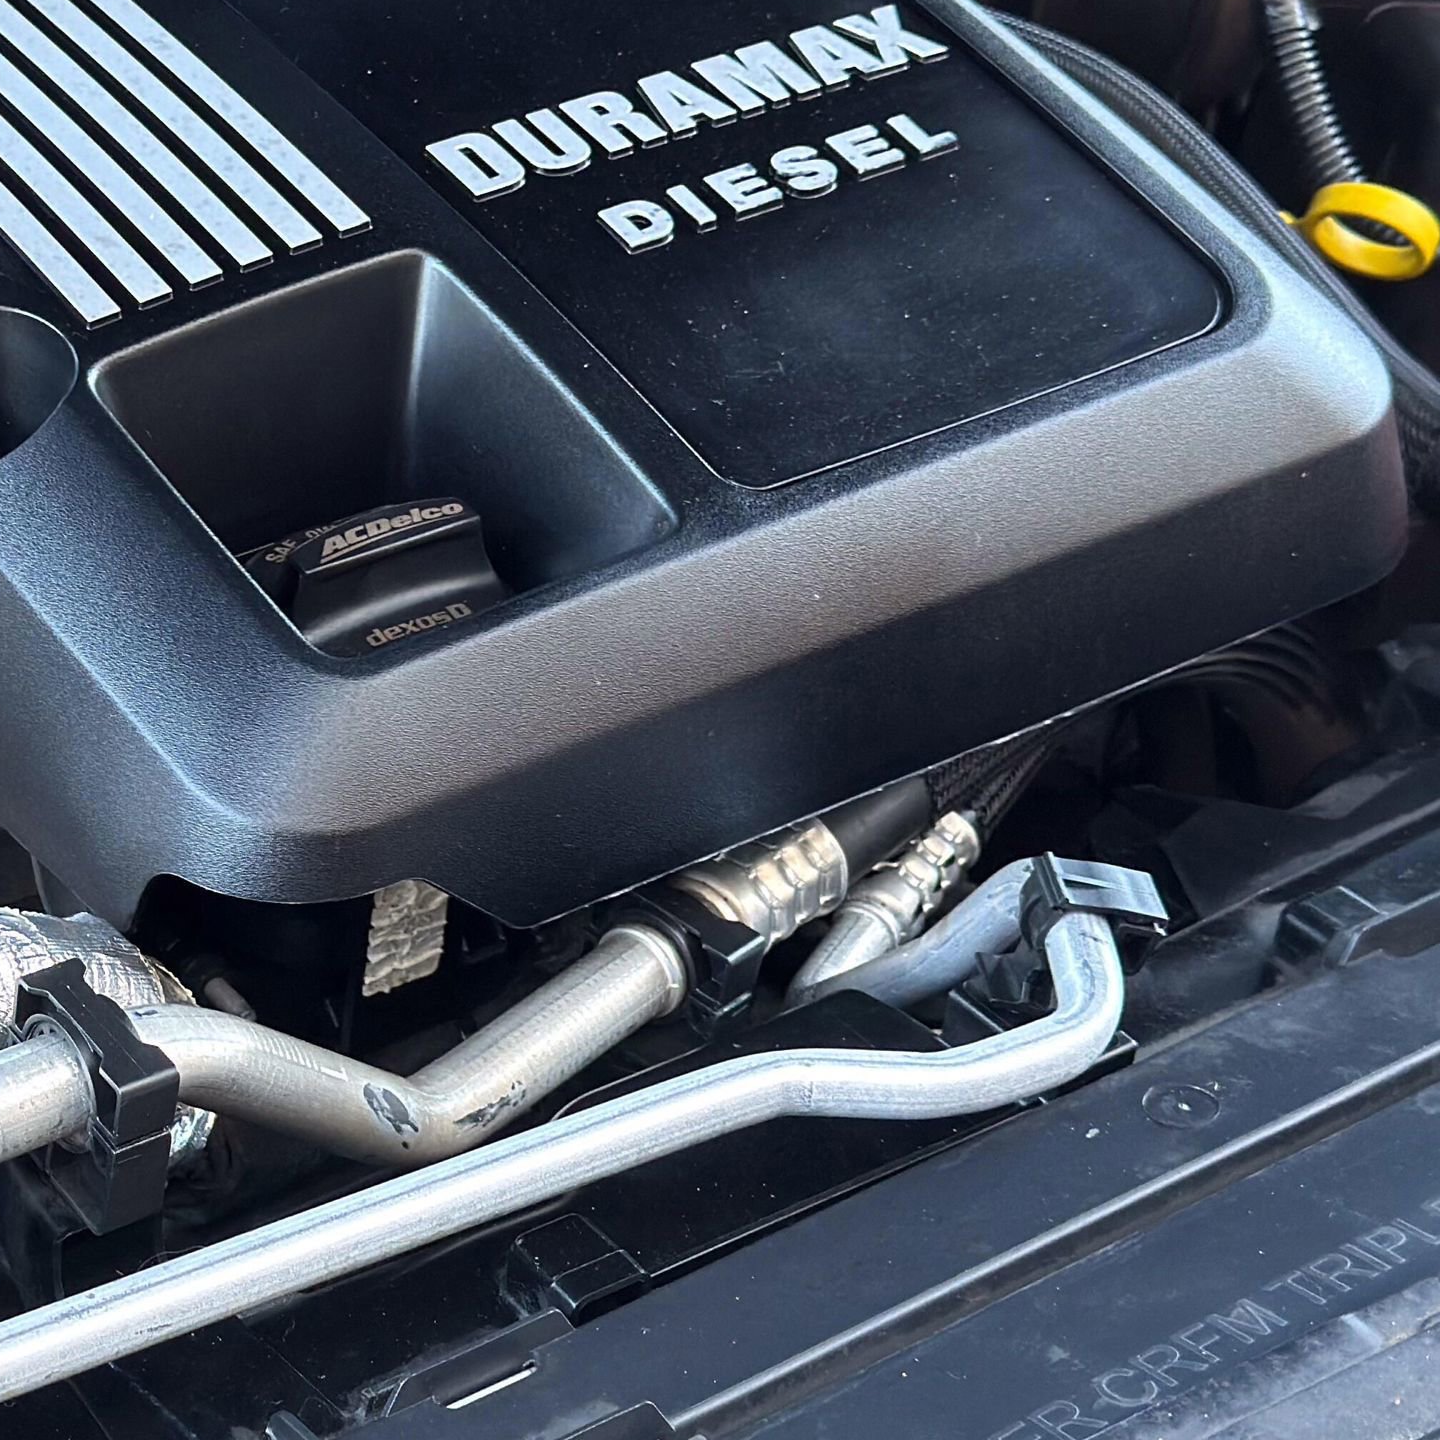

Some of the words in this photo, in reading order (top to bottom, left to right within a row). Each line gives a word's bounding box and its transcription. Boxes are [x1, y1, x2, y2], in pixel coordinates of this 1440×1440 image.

[424, 3, 950, 202] DURAMAX
[597, 113, 960, 255] DIESEL
[320, 502, 464, 559] ACDelco
[1092, 1296, 1289, 1408] CRFM
